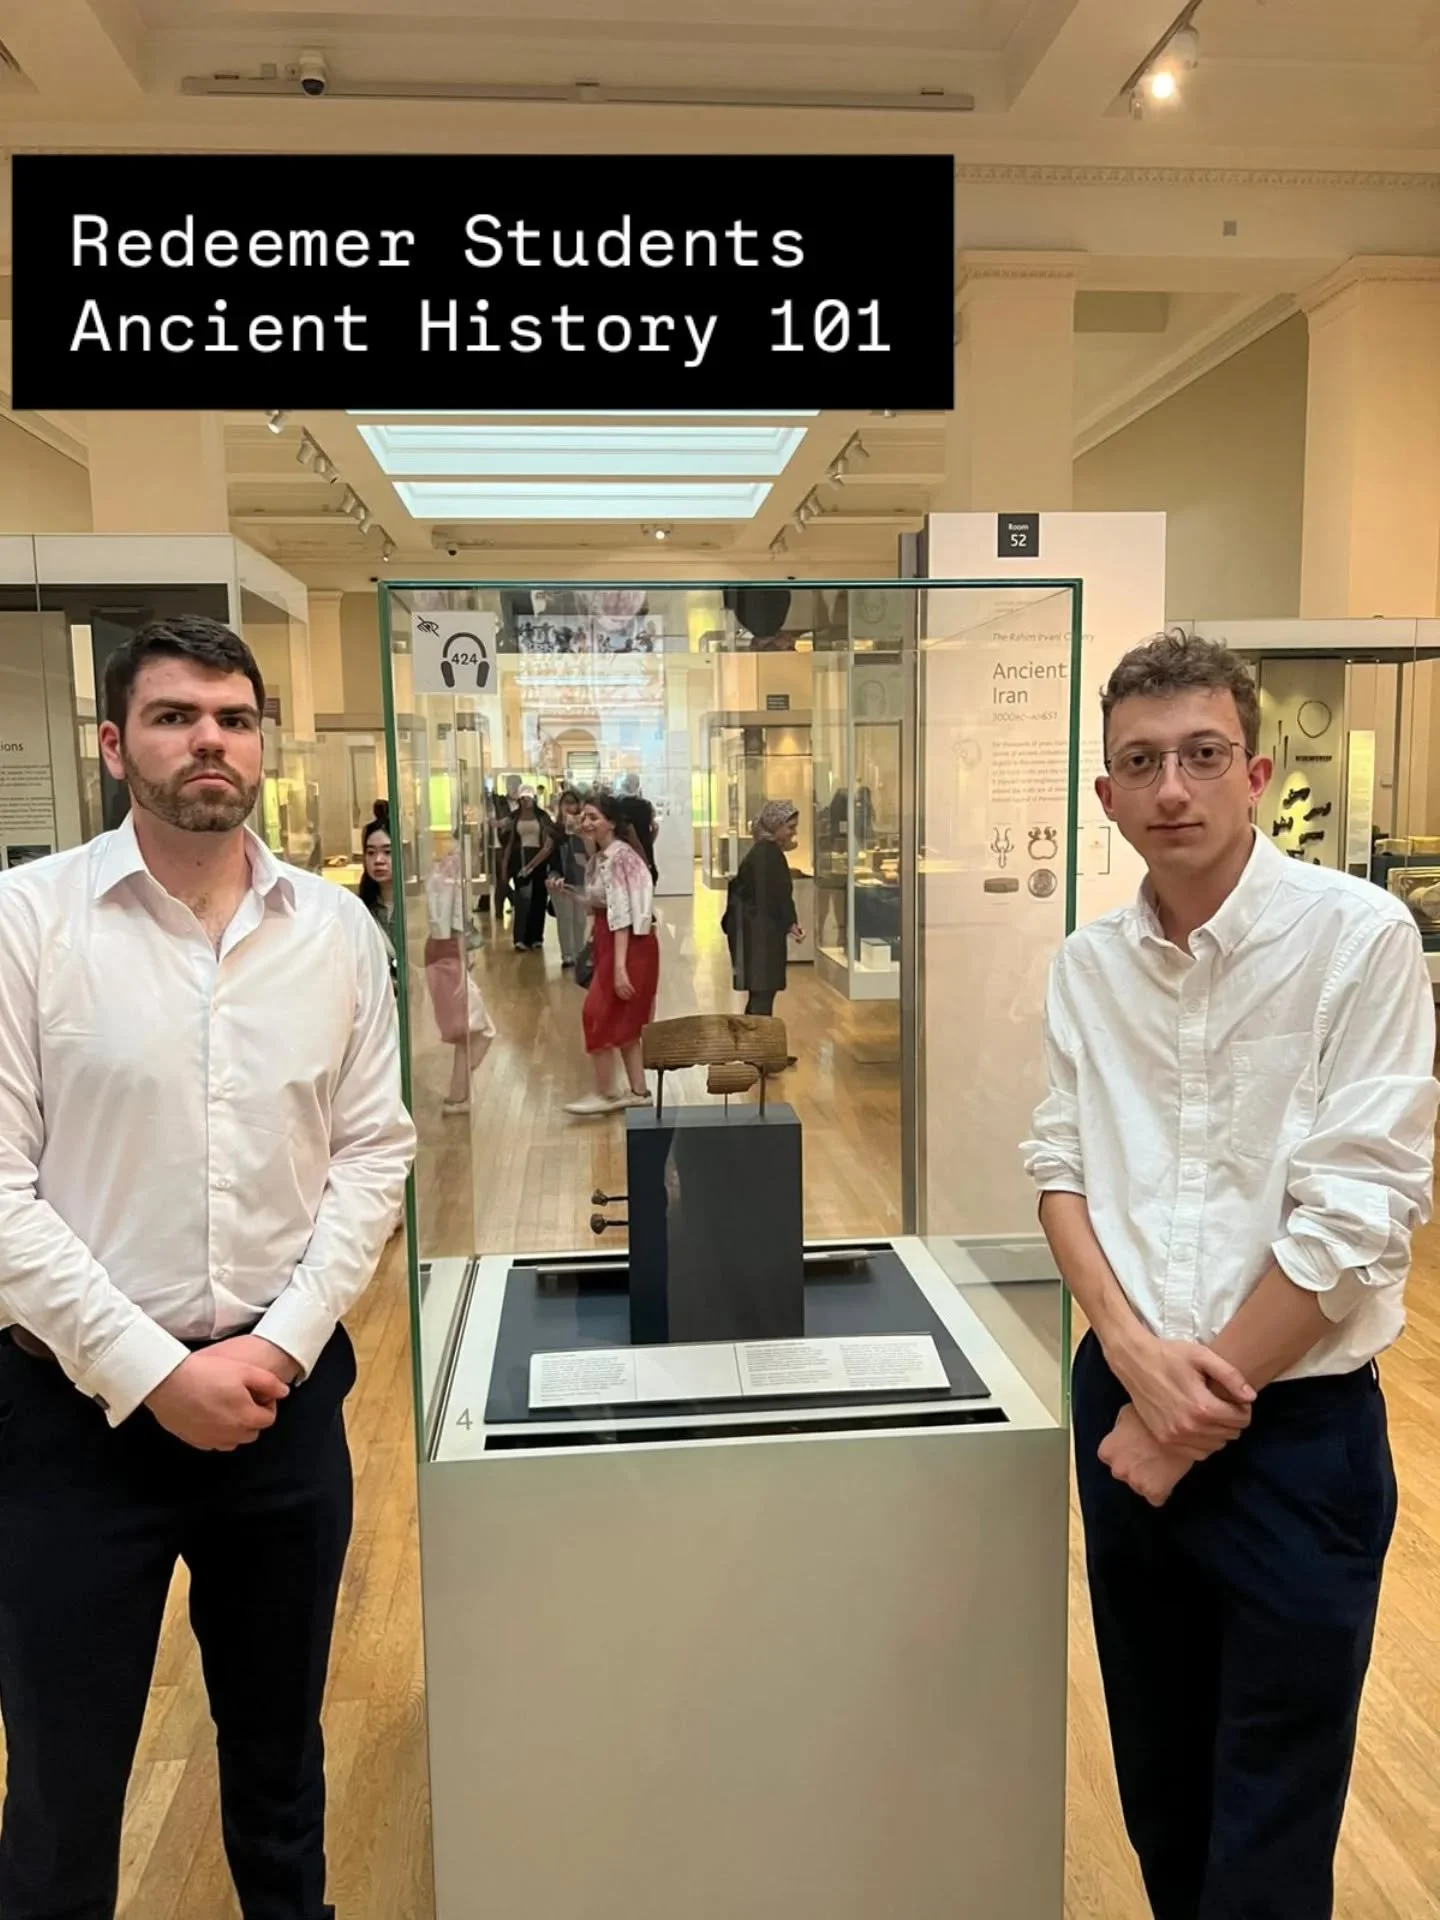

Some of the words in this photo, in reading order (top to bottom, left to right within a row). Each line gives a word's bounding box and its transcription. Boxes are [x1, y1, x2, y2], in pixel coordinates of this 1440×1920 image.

[1008, 523, 1029, 531] Room
[1010, 533, 1027, 547] 52
[451, 652, 478, 665] 424
[992, 661, 1068, 679] Ancient
[992, 686, 1028, 704] Iran
[0, 742, 24, 752] ions
[455, 1407, 474, 1431] 4
